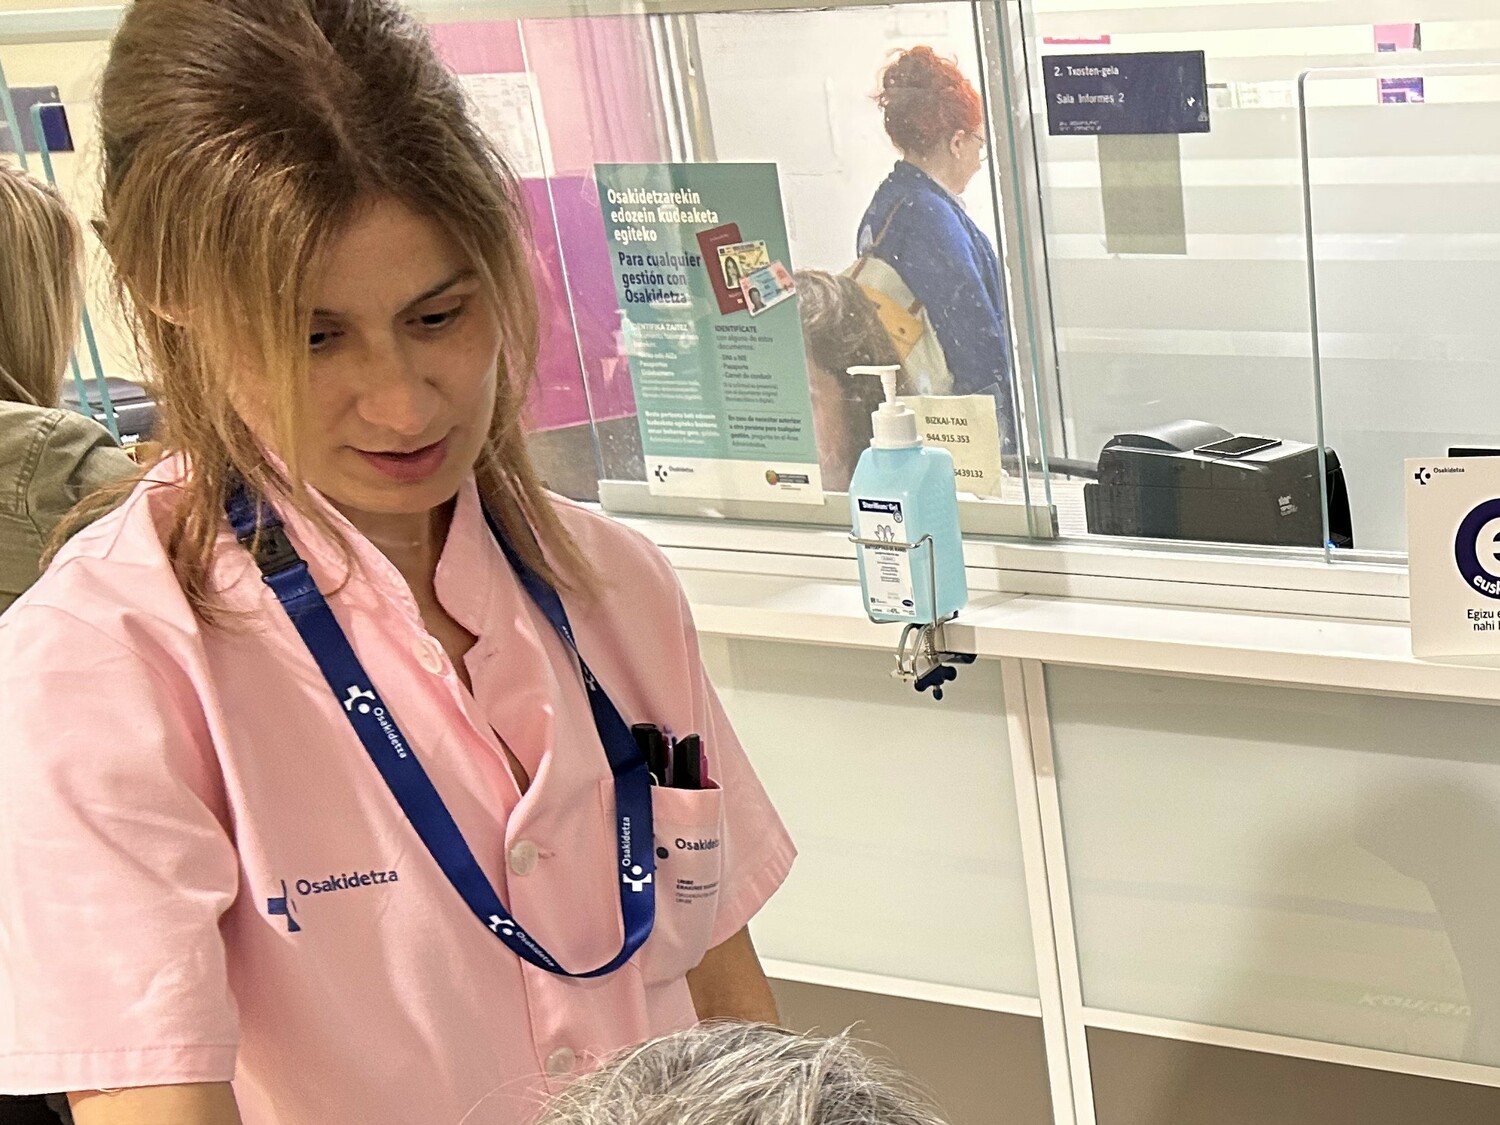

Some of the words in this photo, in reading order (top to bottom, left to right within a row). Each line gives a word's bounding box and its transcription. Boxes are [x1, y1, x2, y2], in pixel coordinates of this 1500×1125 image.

[1054, 66, 1064, 77] 2.
[1067, 66, 1120, 78] Txosten-gela
[1056, 94, 1075, 105] Sala
[1078, 92, 1115, 104] Informes
[1118, 92, 1126, 103] 2
[607, 188, 701, 204] Osakidetzarekin
[610, 207, 656, 223] edozein
[657, 207, 719, 223] kudeaketa
[614, 226, 657, 245] egiteko
[618, 251, 644, 267] Para
[646, 251, 702, 271] cualquier
[622, 270, 664, 289] gestión
[666, 273, 687, 286] con
[625, 289, 688, 304] Osakidetza
[925, 416, 968, 426] BIZKAI-TAXI
[926, 433, 970, 443] 944.915.353
[1467, 609, 1494, 621] Egizu
[1473, 621, 1495, 631] nahi
[373, 706, 407, 759] Osakidetza
[621, 816, 631, 867] Osakidetza
[295, 869, 398, 896] Osakidetza
